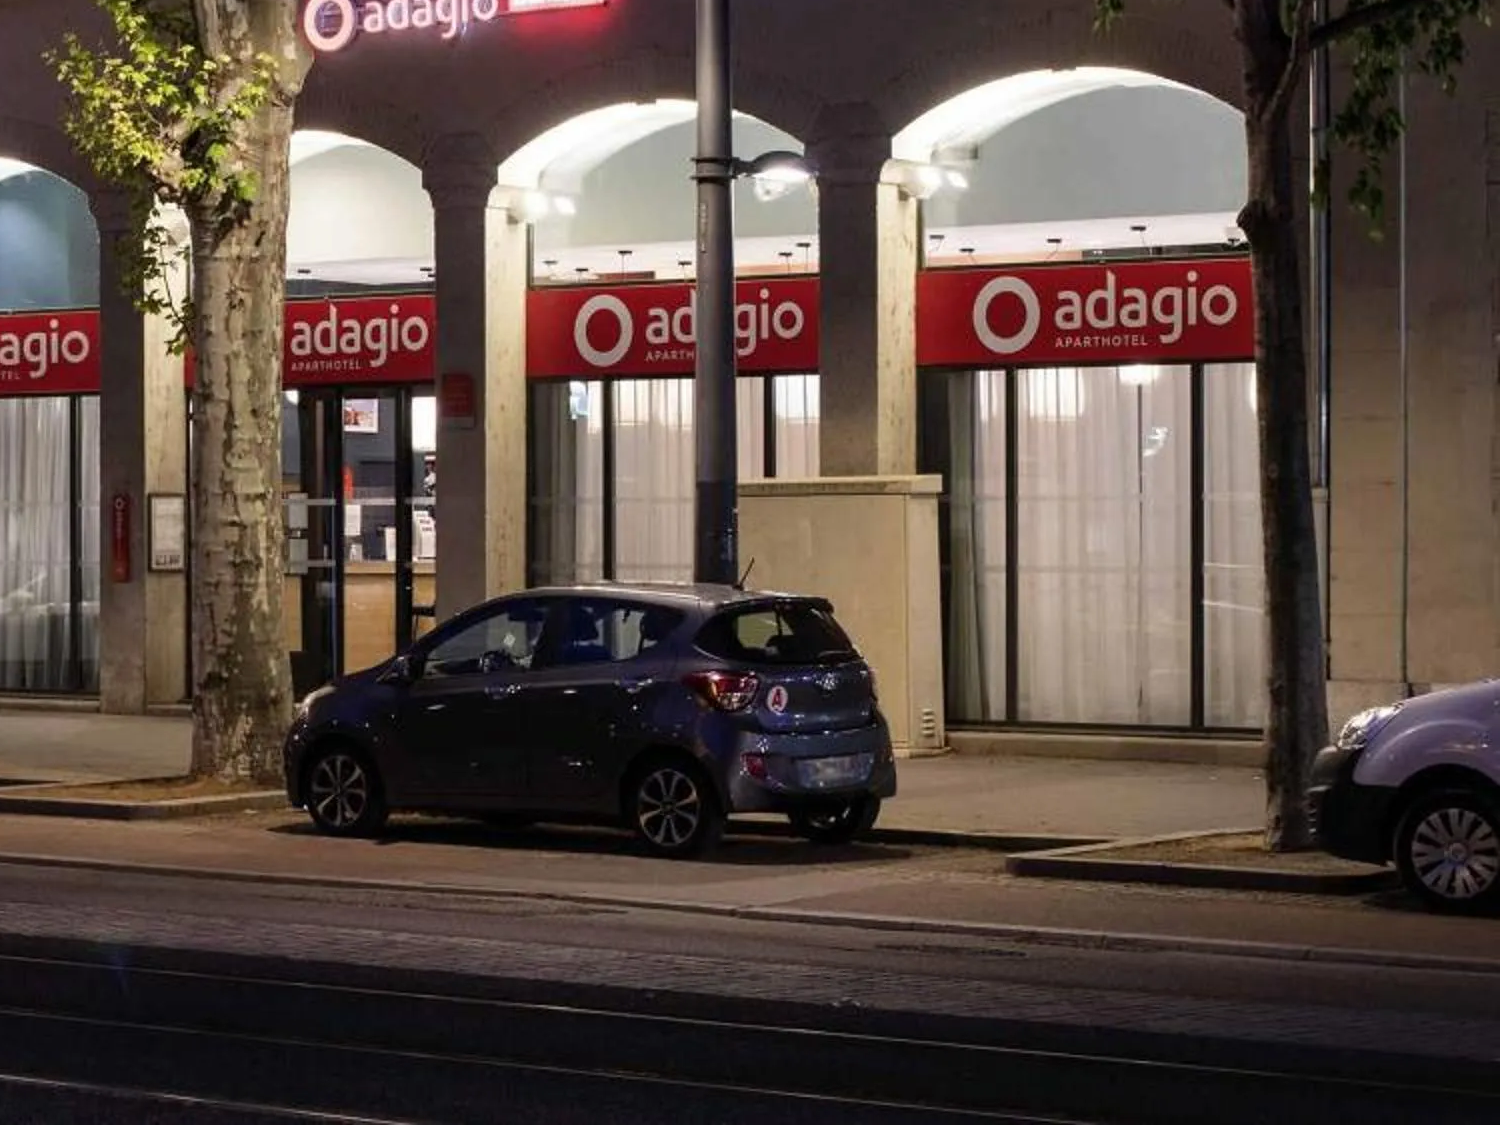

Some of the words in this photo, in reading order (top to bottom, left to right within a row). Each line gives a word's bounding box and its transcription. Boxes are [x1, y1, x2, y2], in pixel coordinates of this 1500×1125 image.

[290, 302, 429, 368] adagio
[645, 287, 805, 356] adgio
[1055, 270, 1238, 344] adagio
[291, 359, 362, 371] APARTHOTEL
[1054, 334, 1149, 349] APARTHOTEL
